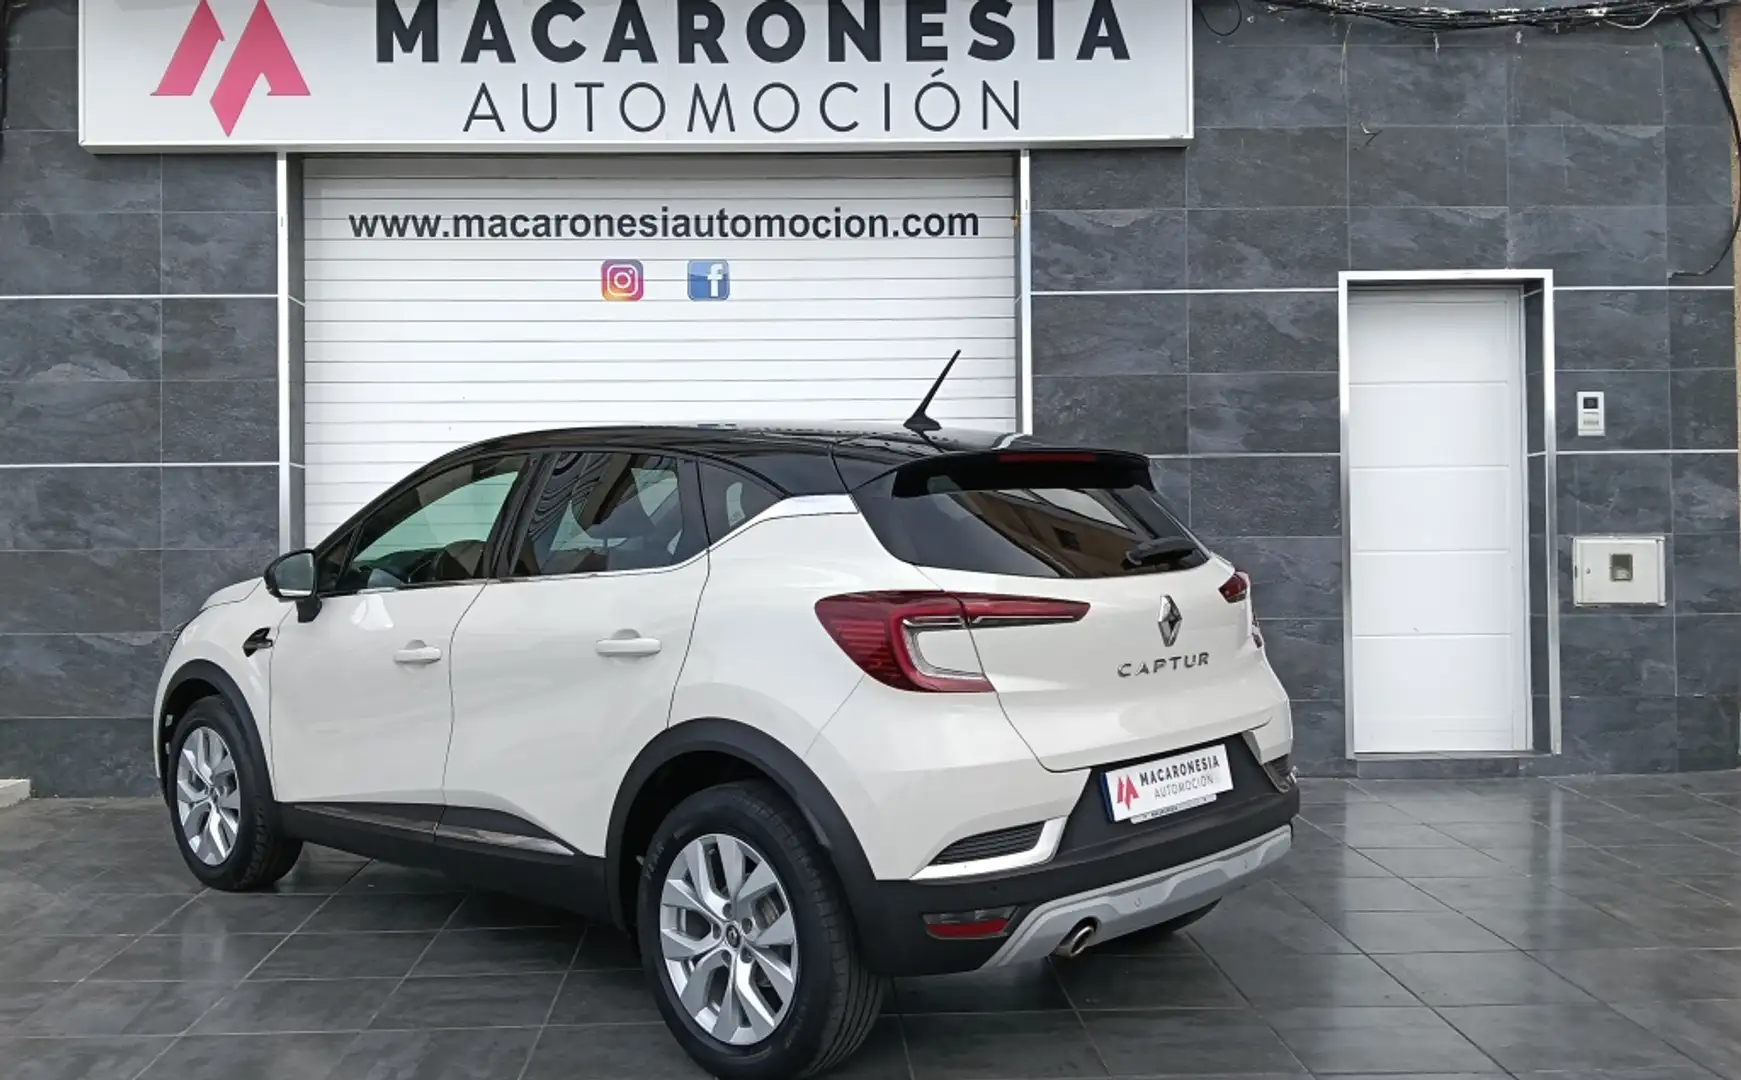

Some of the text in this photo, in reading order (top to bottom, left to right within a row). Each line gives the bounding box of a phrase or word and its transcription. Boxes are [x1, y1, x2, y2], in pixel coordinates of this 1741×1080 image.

[376, 0, 1131, 64] MACARONESIA
[463, 68, 1020, 133] AUTOMOCIÓN
[350, 207, 980, 240] www.macaronesiautomocion.com
[1117, 652, 1210, 677] CAPTUR
[1139, 755, 1220, 786] MACARONESIA
